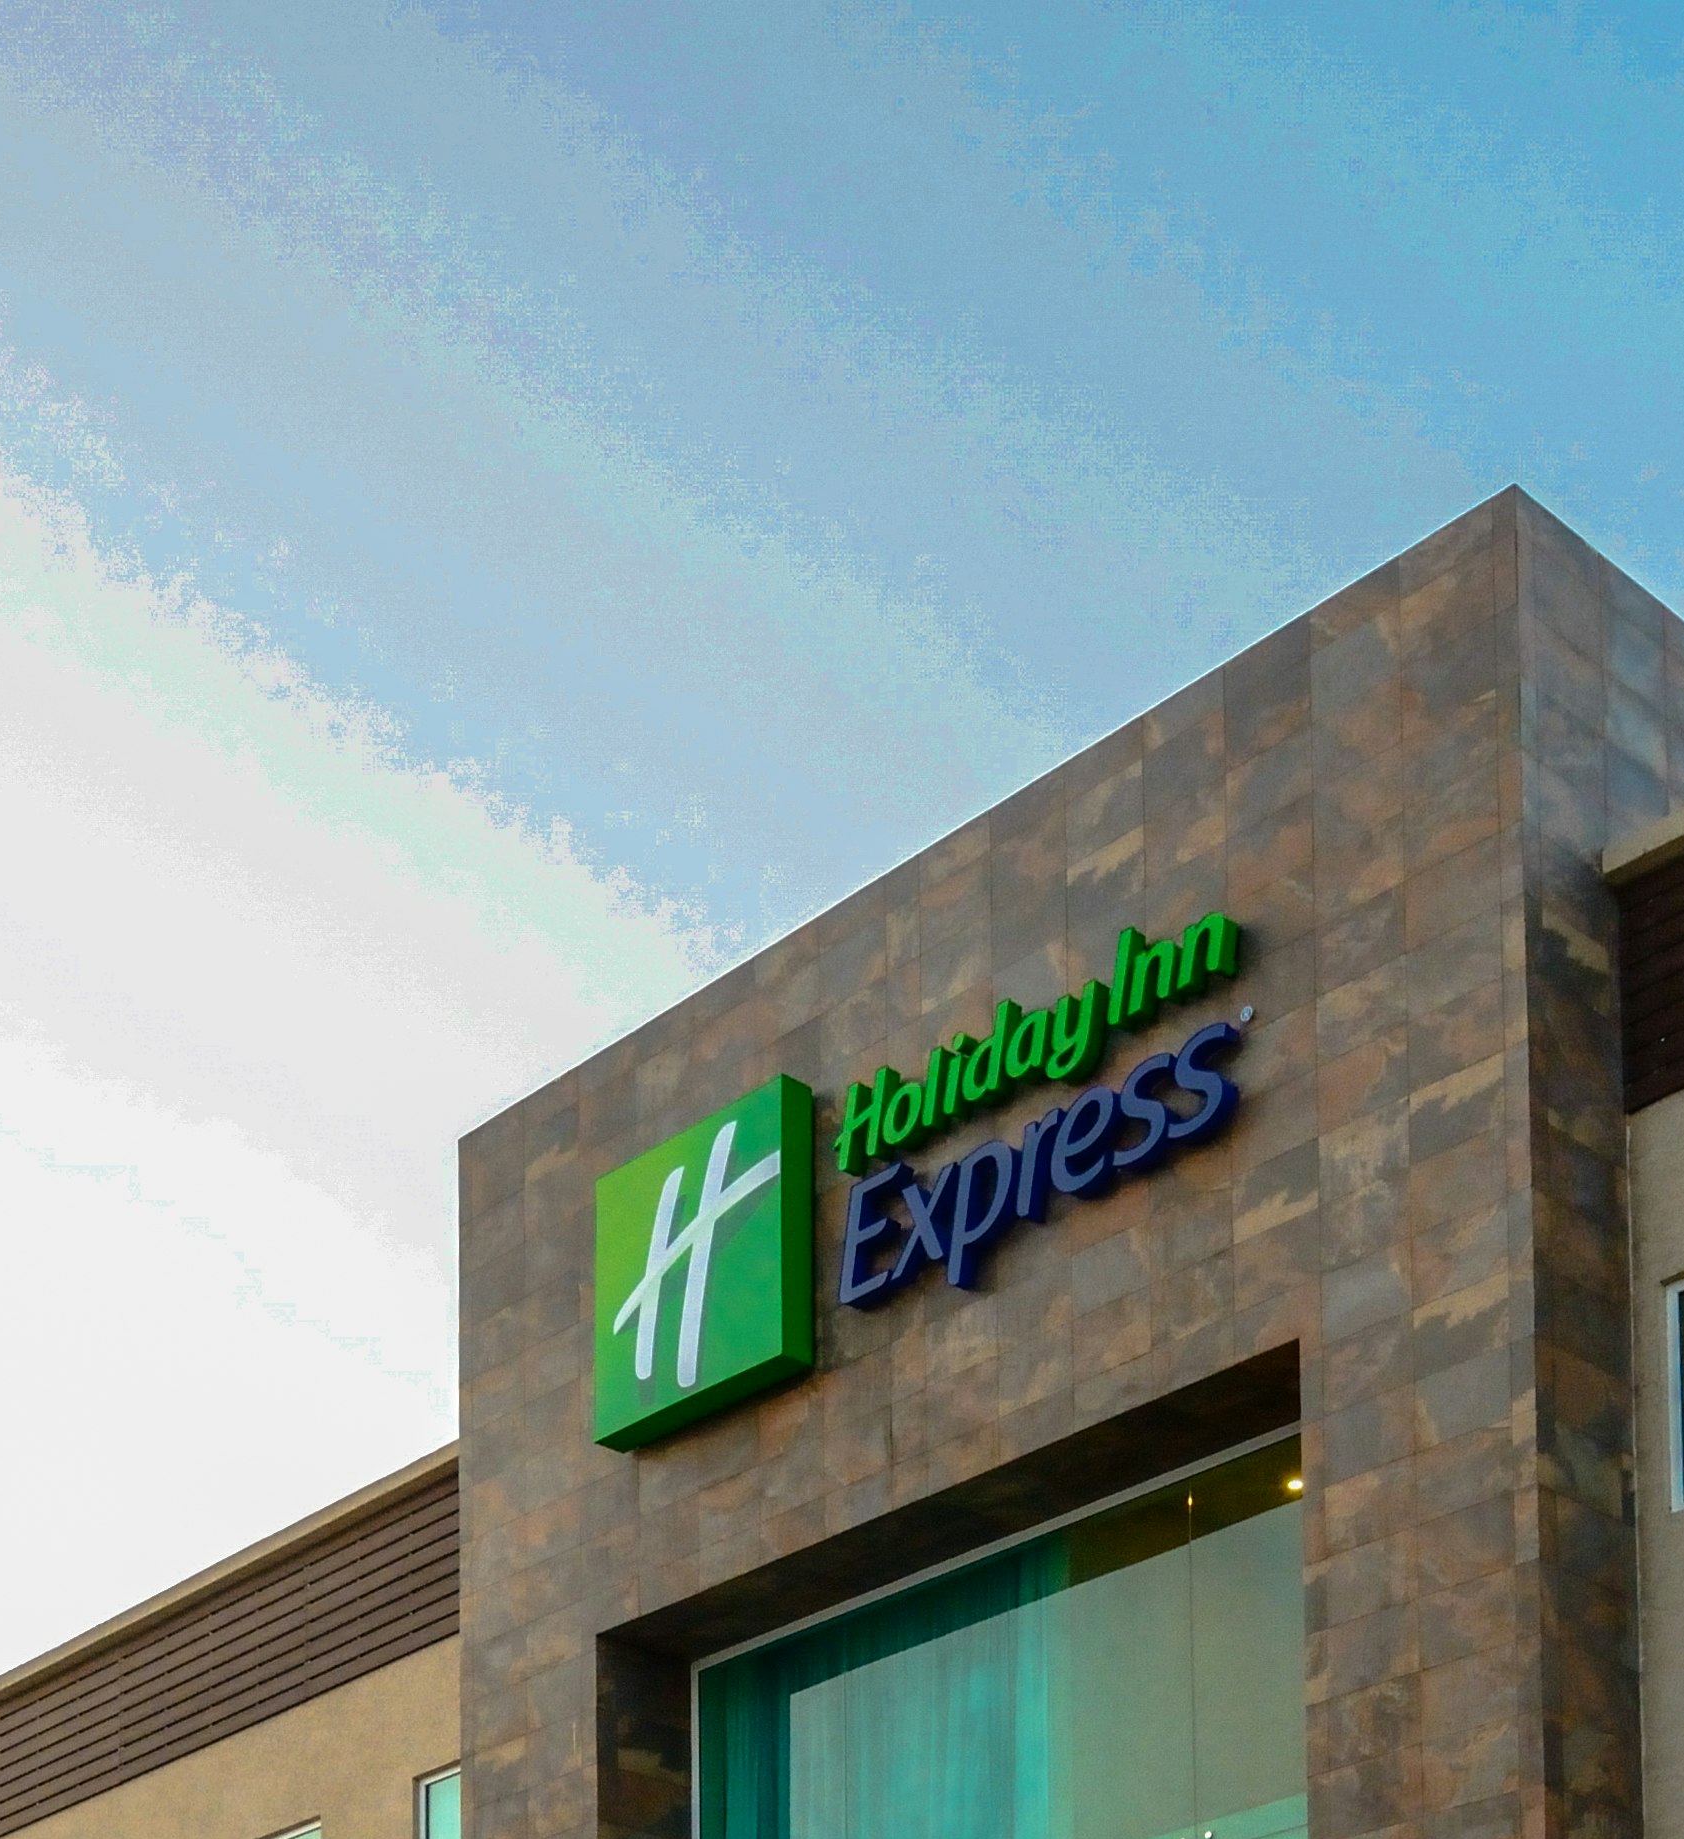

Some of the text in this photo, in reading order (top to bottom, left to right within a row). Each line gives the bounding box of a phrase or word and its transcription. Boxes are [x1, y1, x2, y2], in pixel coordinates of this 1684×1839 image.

[834, 911, 1240, 1176] Holiday Inn
[838, 1021, 1240, 1310] Express
